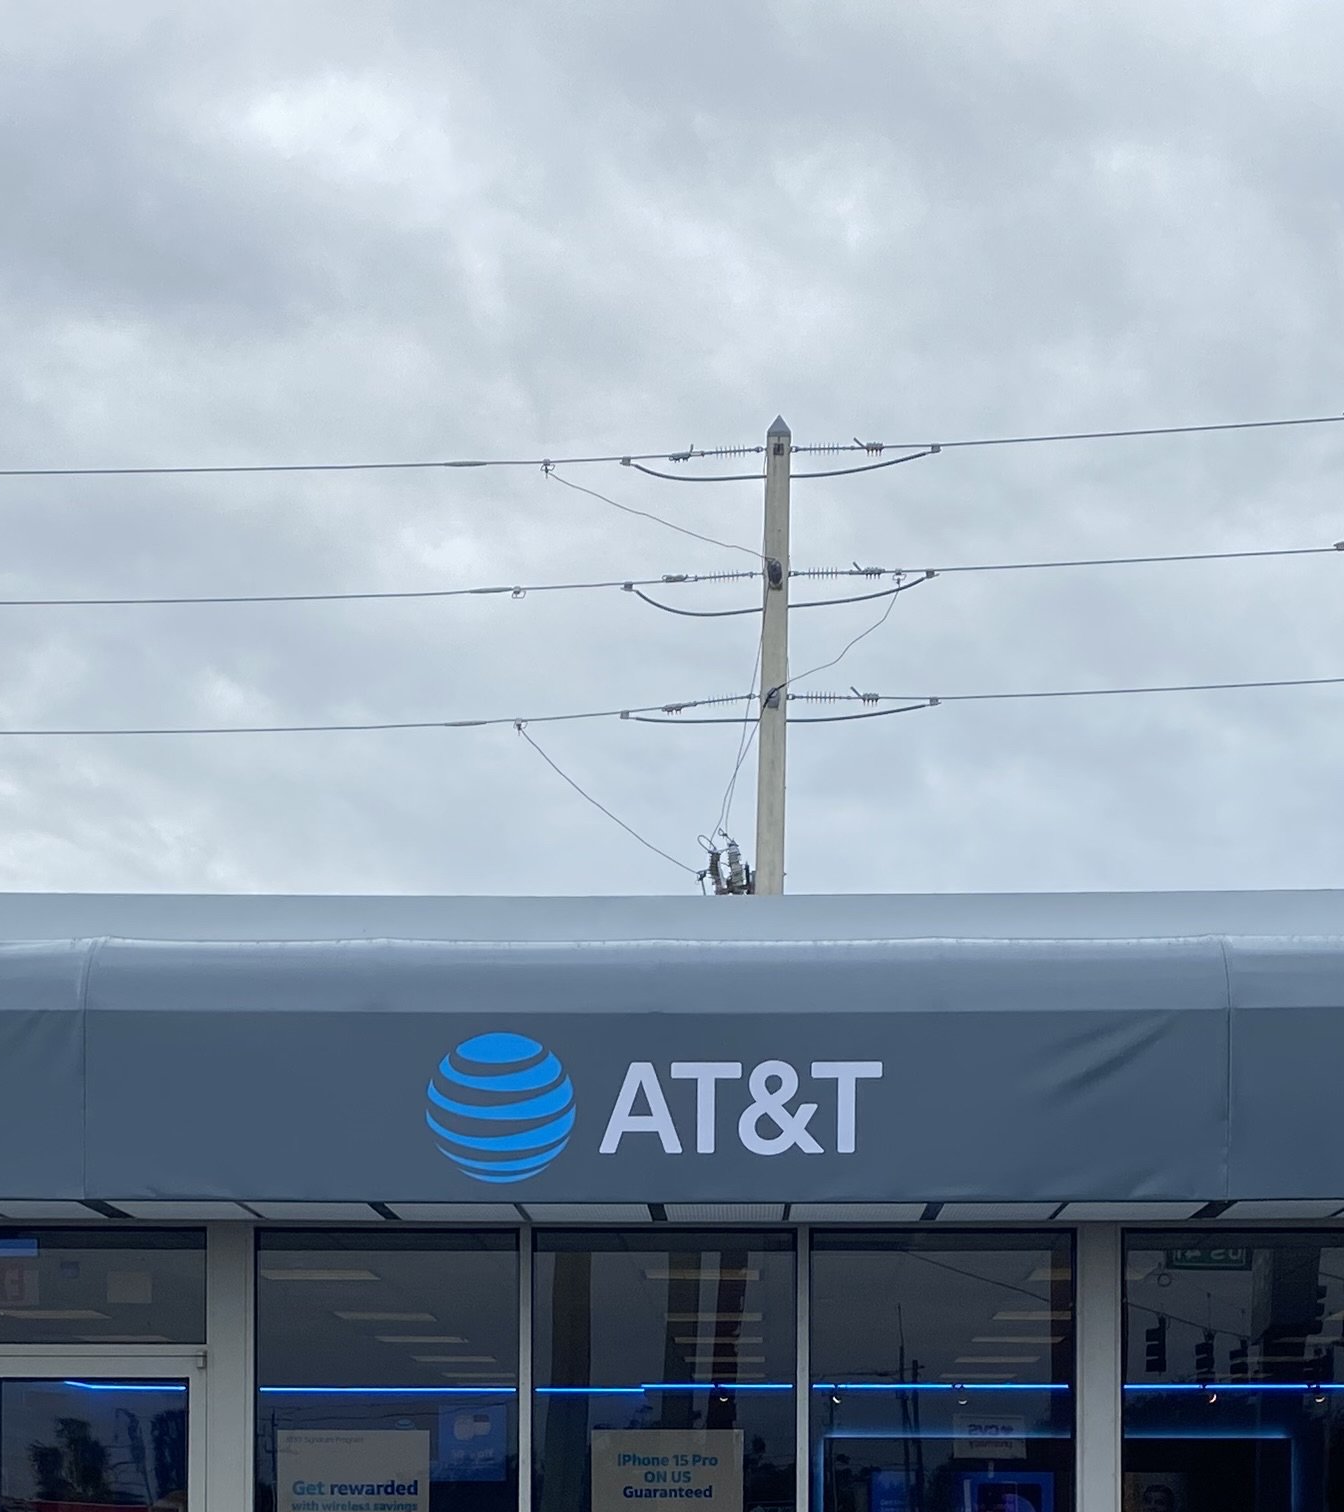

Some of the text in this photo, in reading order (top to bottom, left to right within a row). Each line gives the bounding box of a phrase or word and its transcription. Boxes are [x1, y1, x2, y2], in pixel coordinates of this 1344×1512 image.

[599, 1059, 884, 1156] AT&T
[672, 1454, 689, 1466] 15
[692, 1454, 718, 1466] Pro
[644, 1471, 692, 1483] ON US
[292, 1479, 418, 1496] Get rewarded
[623, 1484, 713, 1498] Guaranteed
[291, 1500, 319, 1511] with
[322, 1500, 370, 1511] wireless
